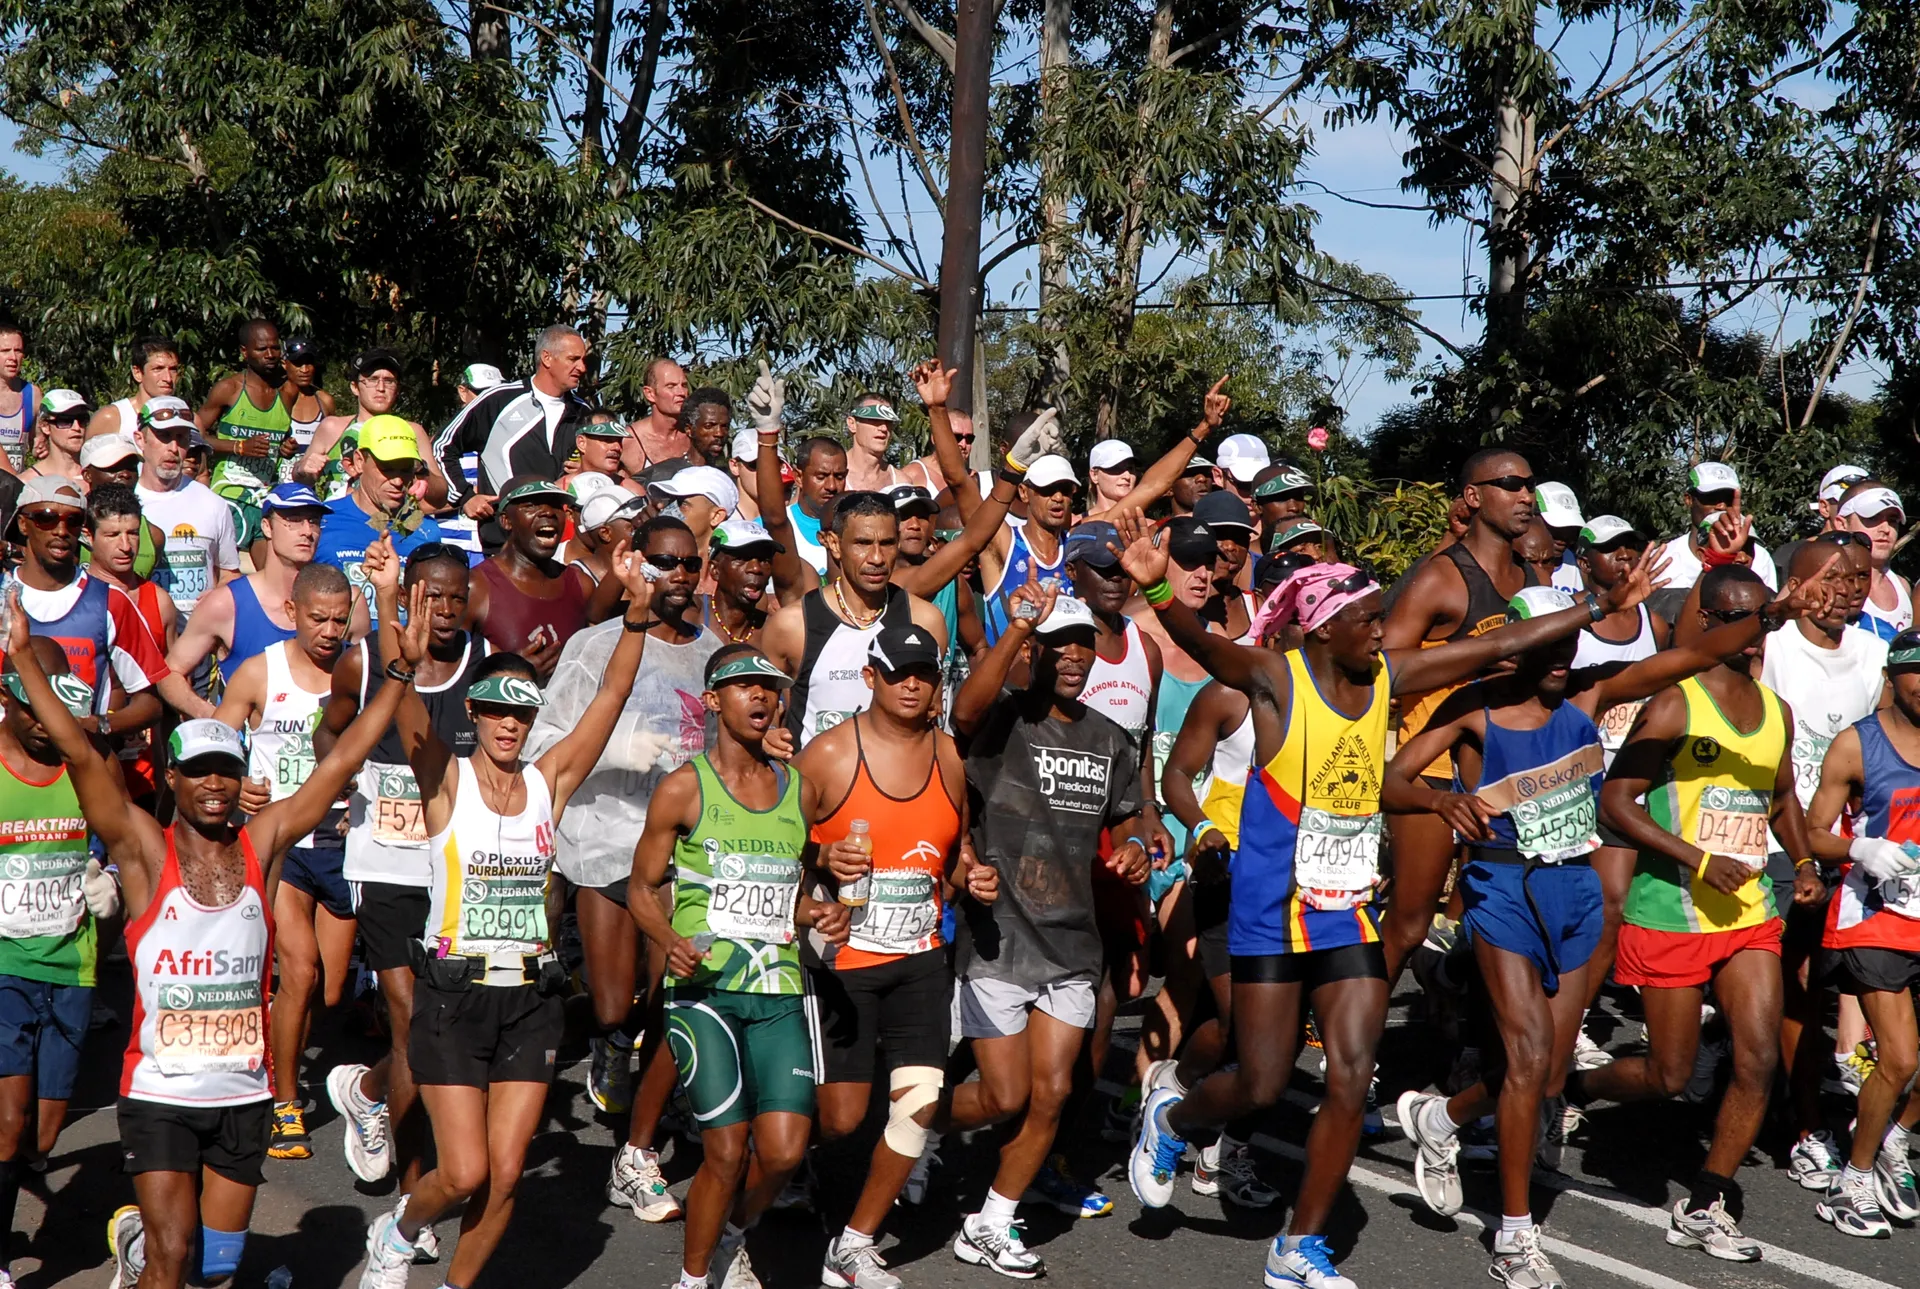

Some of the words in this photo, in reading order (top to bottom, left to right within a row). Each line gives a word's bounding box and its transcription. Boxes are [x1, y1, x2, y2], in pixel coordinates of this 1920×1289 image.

[166, 554, 203, 563] EDBANK
[336, 550, 365, 558] www.r
[1120, 680, 1149, 703] ATHLET
[1108, 697, 1129, 706] CLUB
[273, 719, 306, 733] RUN
[1308, 735, 1347, 791] ZULULAND
[1354, 733, 1372, 763] MULTI
[1366, 763, 1382, 796] SPORT
[1538, 761, 1584, 790] Eskom
[1058, 780, 1092, 794] medical
[1541, 782, 1588, 810] NEDBANK
[1065, 799, 1081, 809] what
[1332, 799, 1361, 810] CLUB
[0, 817, 87, 835] REAKTHRU
[15, 832, 68, 843] MIDRAND
[488, 853, 541, 866] Plexus
[467, 864, 543, 877] DURBANVILLE
[872, 865, 932, 876] rcelorMittal
[490, 886, 544, 897] NEDBANK
[29, 910, 64, 923] WILMOT
[466, 907, 542, 941] C8991
[153, 949, 260, 977] AfriSam
[196, 987, 256, 1003] NEDBANK
[159, 1011, 259, 1048] C31808
